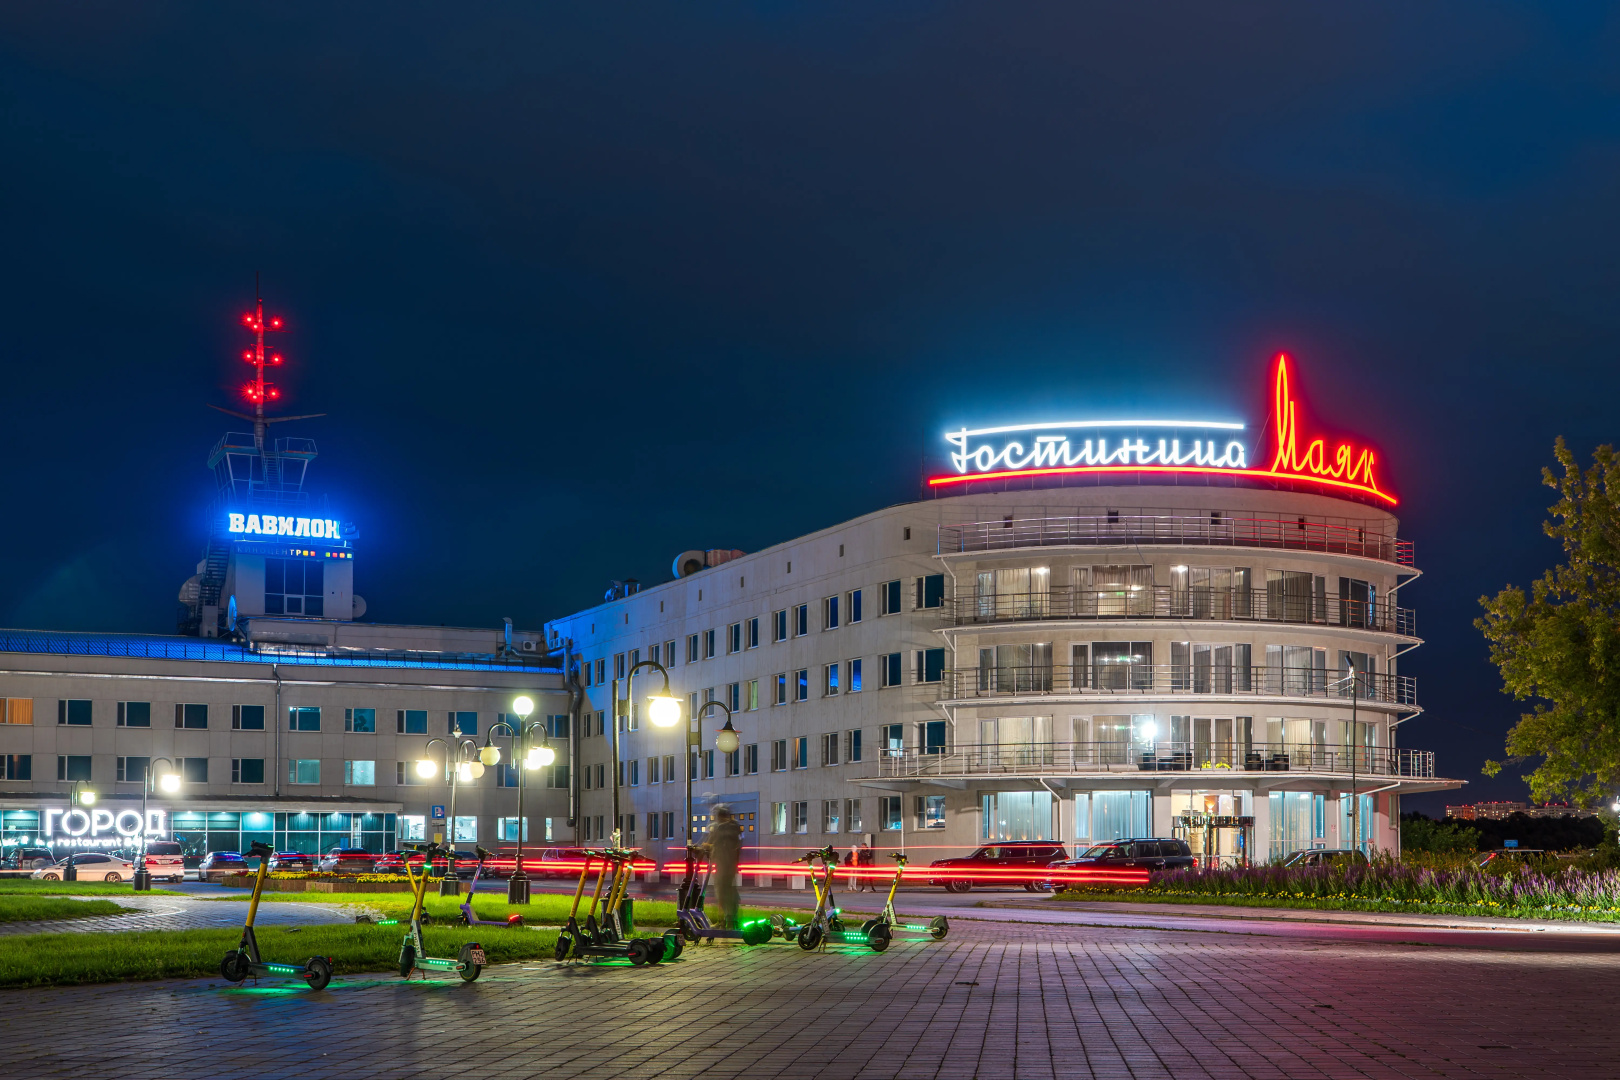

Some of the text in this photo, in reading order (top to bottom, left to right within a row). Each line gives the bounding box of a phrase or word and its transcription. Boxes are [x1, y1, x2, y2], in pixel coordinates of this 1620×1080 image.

[945, 354, 1378, 491] Гостиница Маяк
[228, 513, 341, 539] ВАВИЛОН
[45, 808, 167, 837] ГОРОД
[57, 837, 121, 847] restaurant
